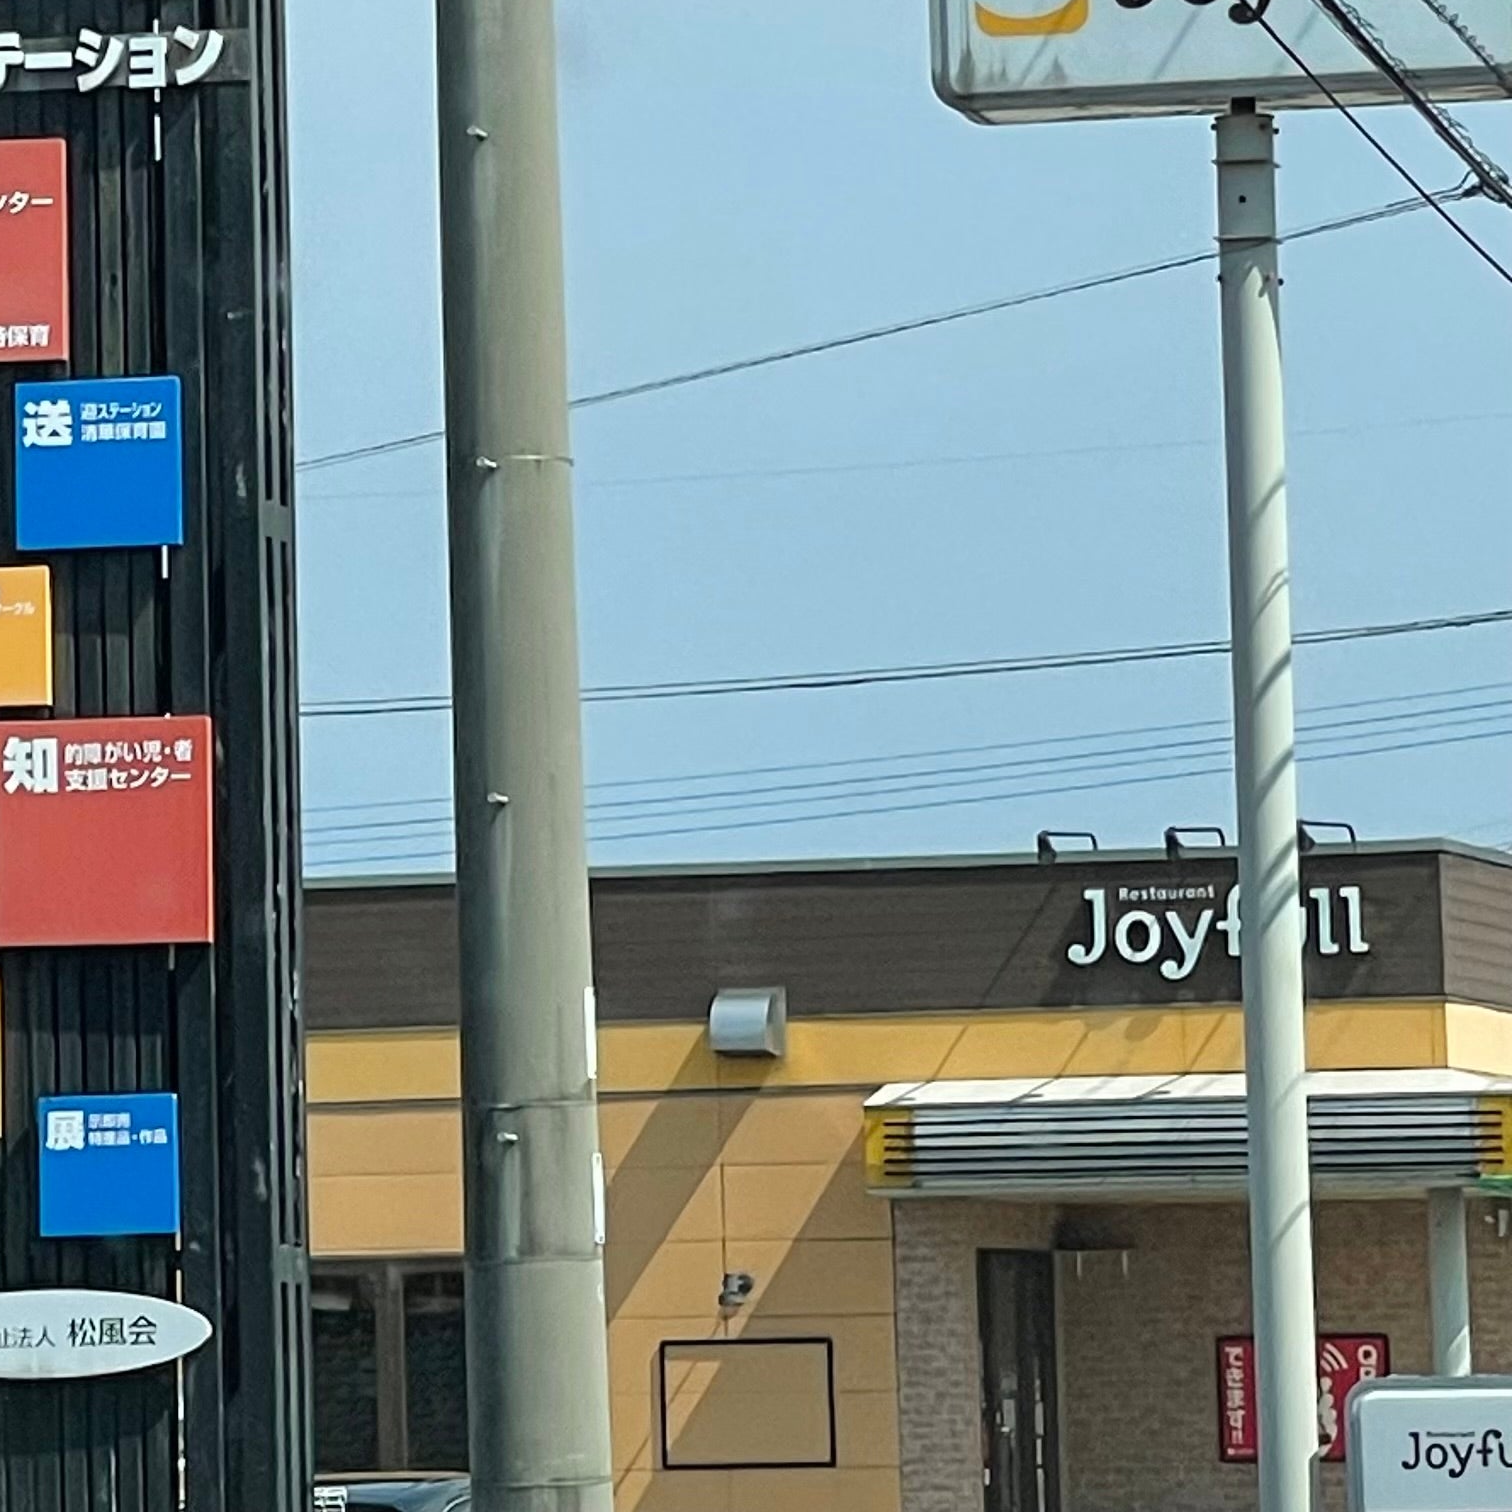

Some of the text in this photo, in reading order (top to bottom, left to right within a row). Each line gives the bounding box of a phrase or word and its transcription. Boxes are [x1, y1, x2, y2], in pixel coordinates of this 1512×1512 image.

[2, 736, 59, 794] 知
[64, 766, 192, 792] 支援センター
[1118, 884, 1216, 902] Restaurant
[1067, 884, 1370, 981] Joyfll
[66, 1315, 158, 1348] 松風会
